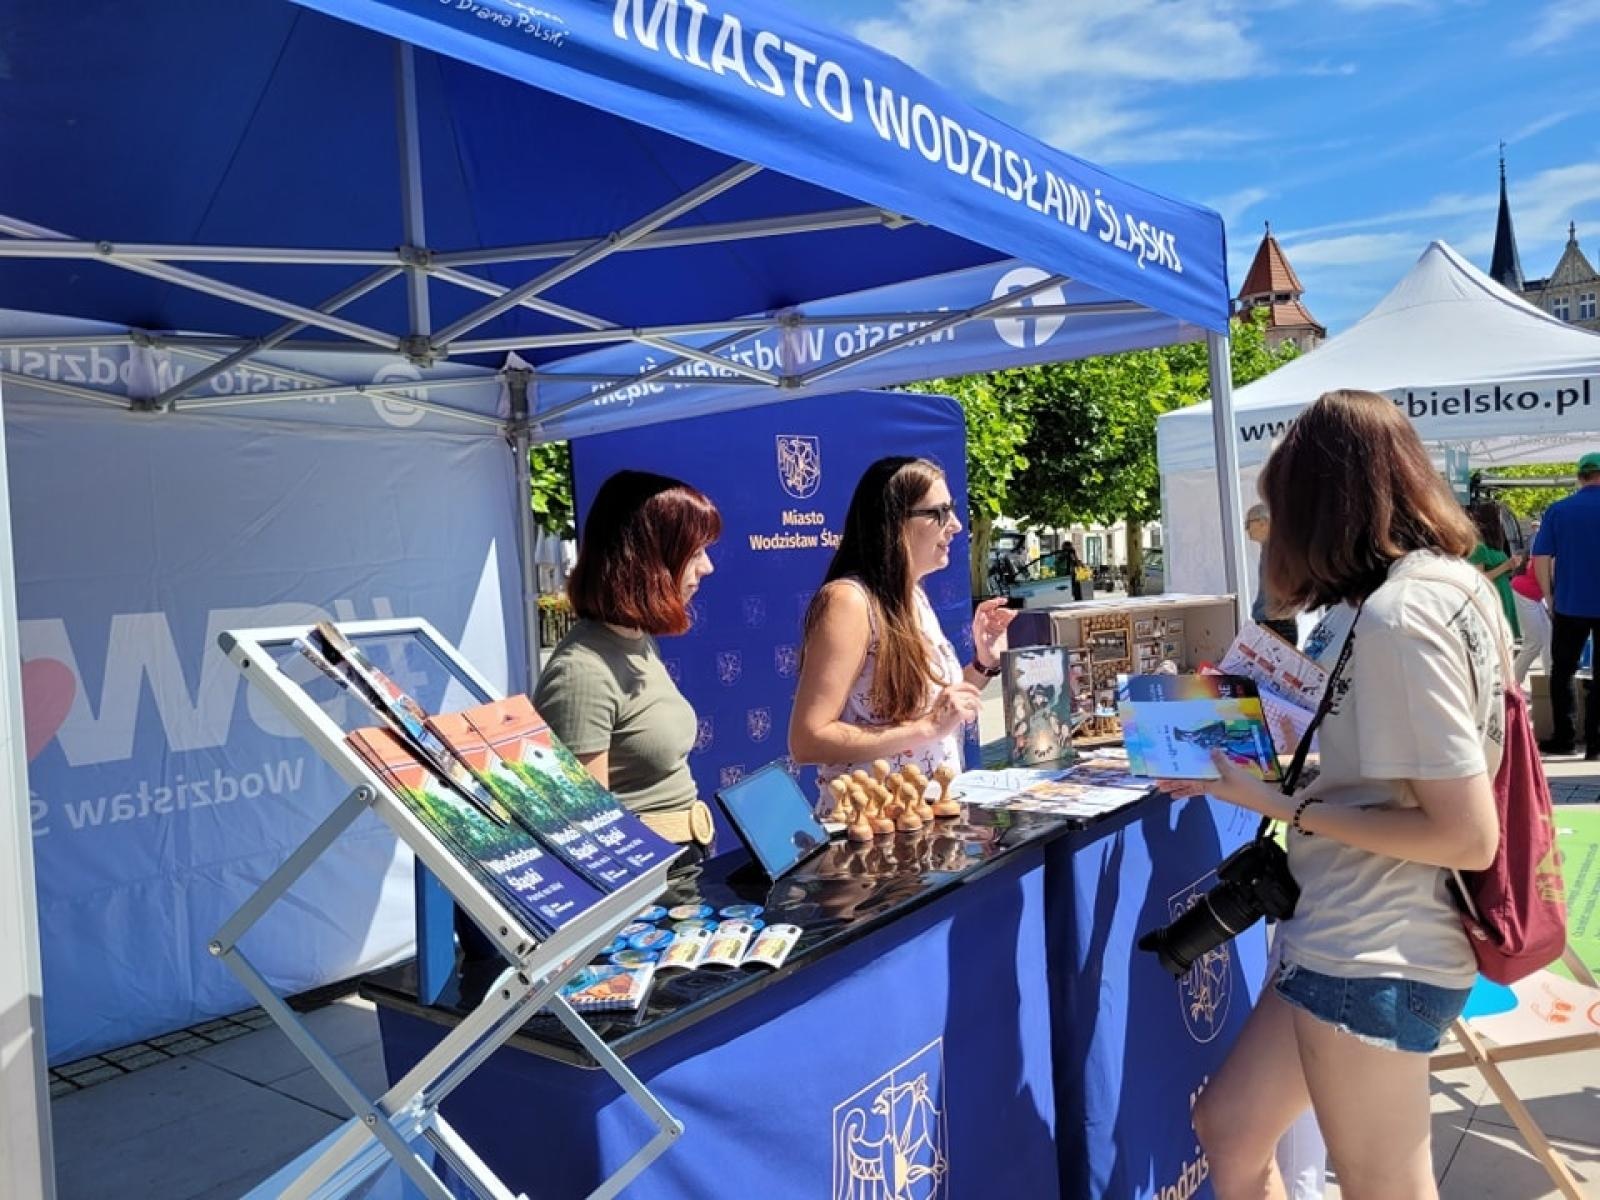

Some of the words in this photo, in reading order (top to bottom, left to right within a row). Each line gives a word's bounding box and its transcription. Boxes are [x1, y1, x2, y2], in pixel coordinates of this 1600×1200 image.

[611, 0, 854, 124] MIASTO
[863, 78, 1092, 233] WODZISŁAW
[1094, 189, 1184, 272] ŚLĄSKI
[782, 508, 825, 526] Miasto
[749, 531, 818, 550] Wodzisław
